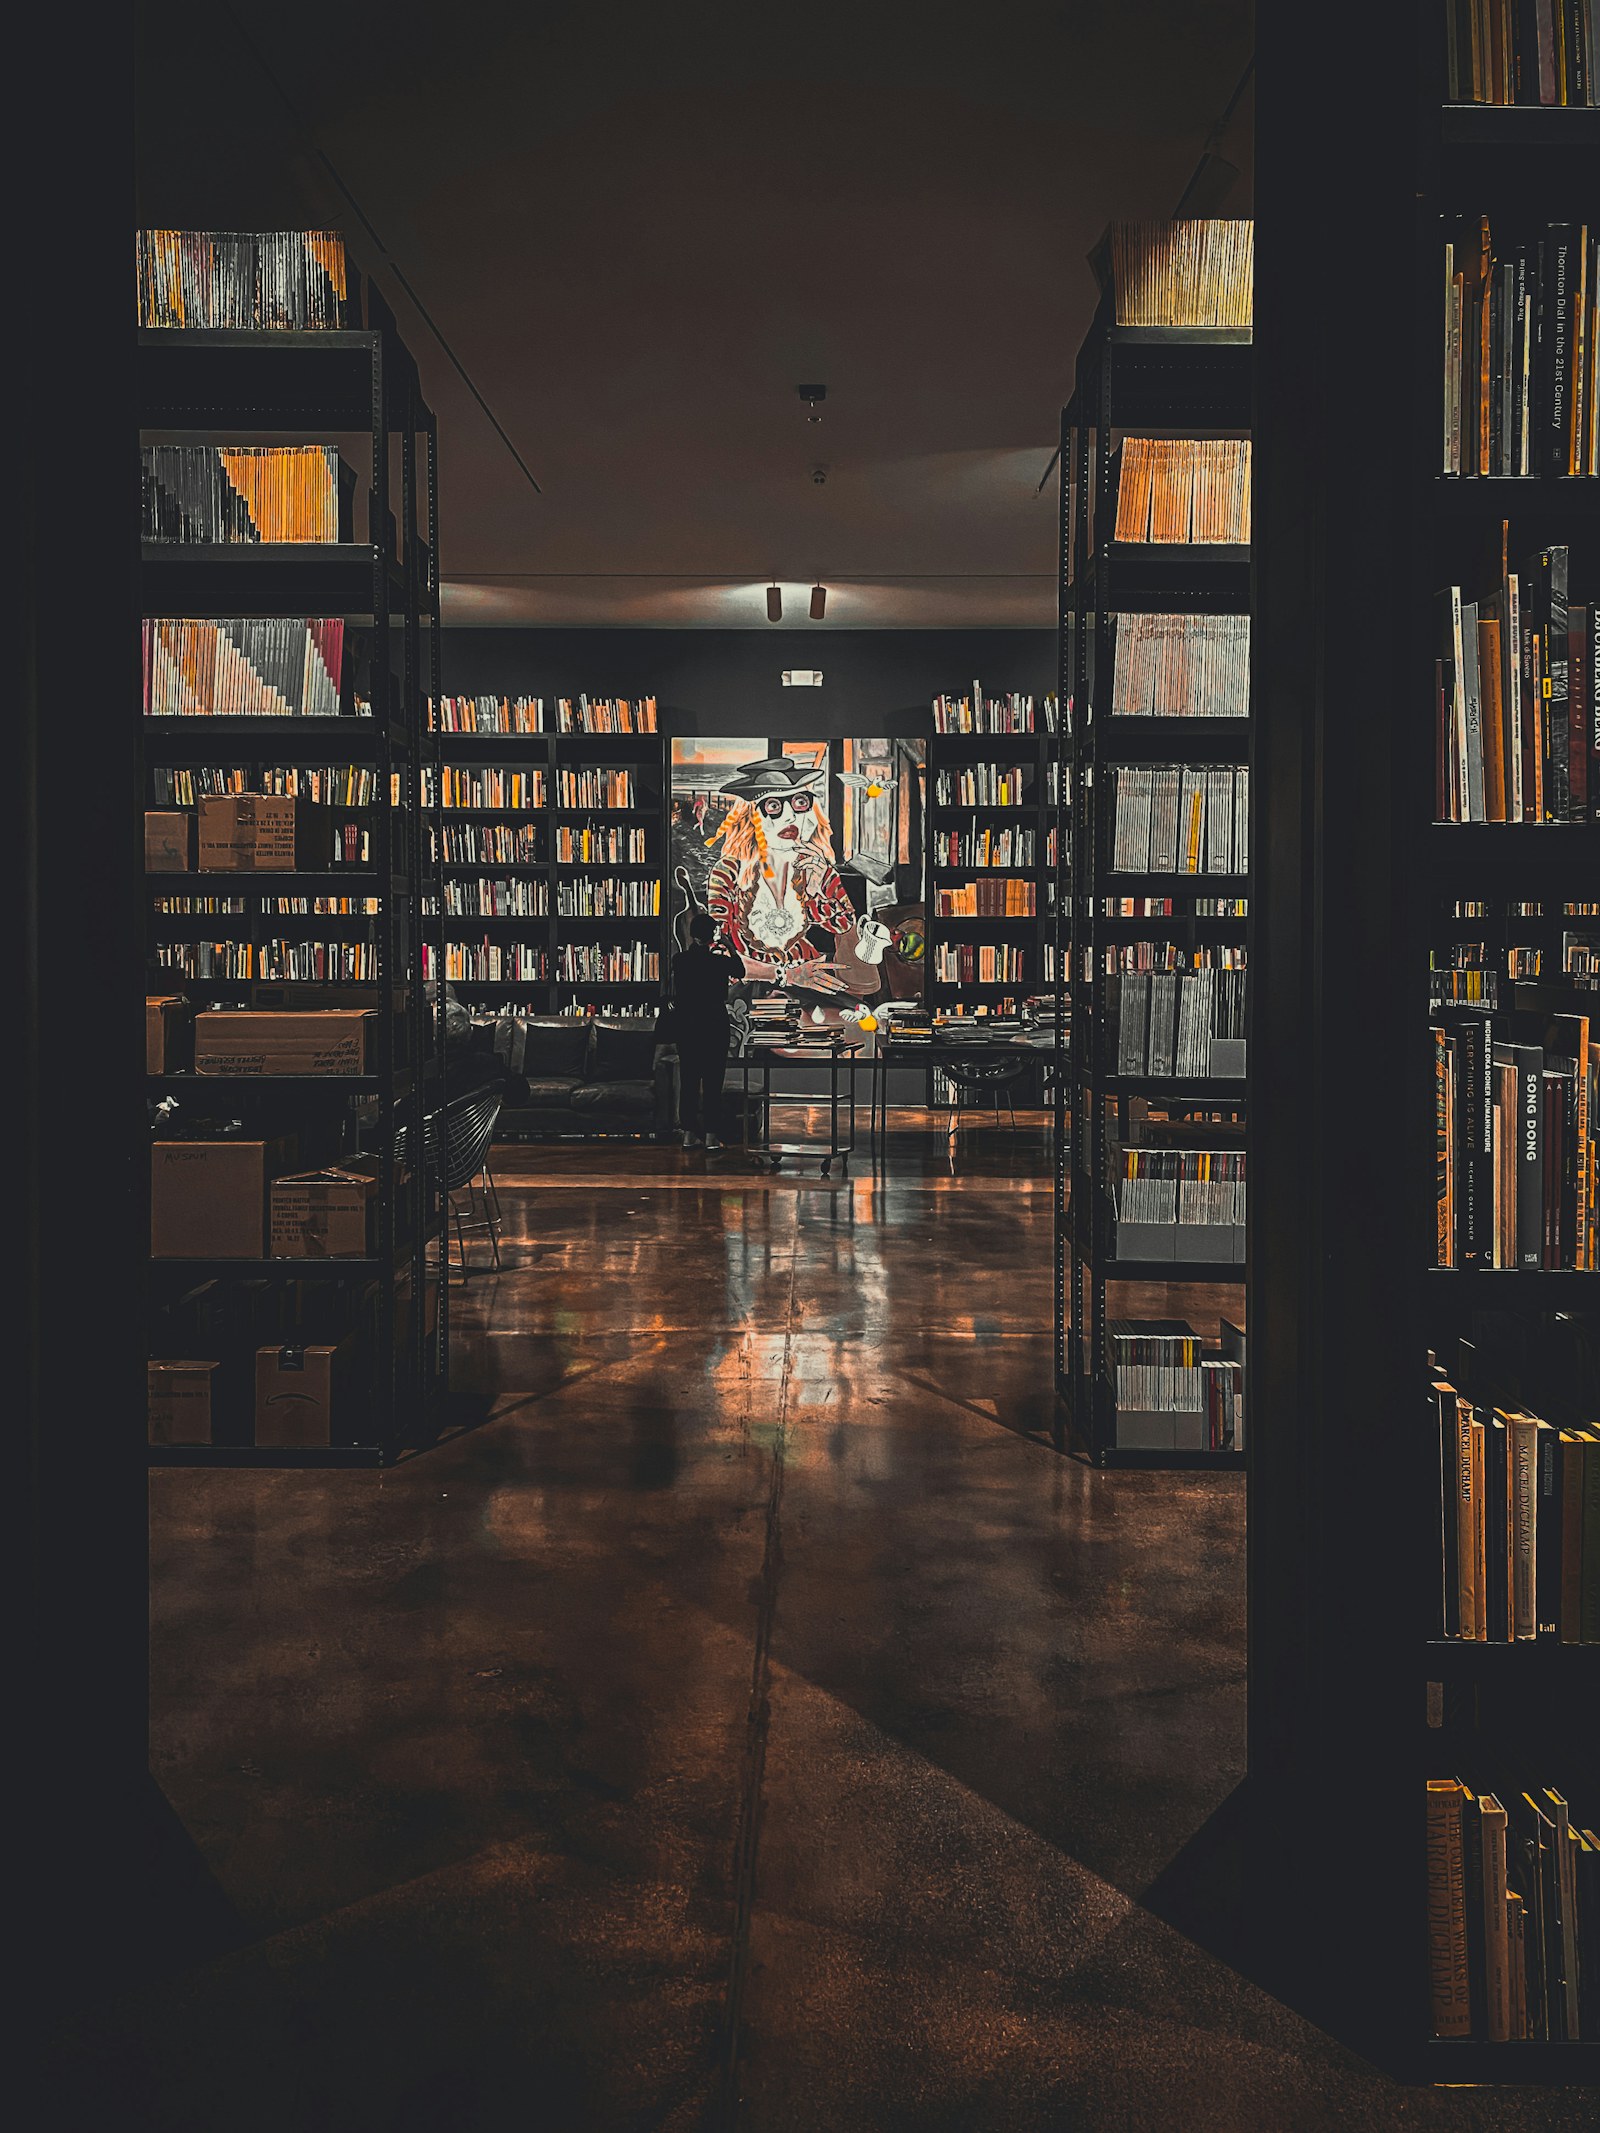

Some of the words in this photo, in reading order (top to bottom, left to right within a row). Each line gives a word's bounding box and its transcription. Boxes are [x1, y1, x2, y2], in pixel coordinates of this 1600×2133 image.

[1556, 246, 1568, 295] Thornton
[1518, 282, 1526, 306] Omega
[1556, 298, 1566, 320] Dial
[1556, 322, 1565, 333] in
[1555, 336, 1565, 355] the
[1555, 357, 1565, 382] 21st
[1552, 384, 1564, 429] Century
[1512, 616, 1518, 624] DI
[1523, 627, 1532, 646] Mark
[1523, 646, 1531, 654] di
[1523, 654, 1532, 679] Suvero
[1484, 1019, 1492, 1053] MICHELE
[1466, 1029, 1475, 1099] EVERYTHING
[1484, 1053, 1492, 1070] OKA
[1484, 1071, 1492, 1097] DONER
[1526, 1073, 1537, 1115] SONG
[1466, 1103, 1475, 1114] IS
[1466, 1117, 1475, 1149] ALIVE
[1526, 1119, 1537, 1162] DONG
[1461, 1414, 1471, 1453] MARCEL
[1461, 1455, 1471, 1502] DUCHAMP
[1518, 1444, 1529, 1496] MARCEL
[1519, 1495, 1531, 1555] DUCHAMP
[1449, 1813, 1462, 1842] THE
[1427, 1812, 1449, 1899] MARCEL
[1450, 1846, 1465, 1925] COMPLETE
[1429, 1903, 1453, 2006] DUCHAMP
[1454, 1929, 1467, 1982] WORKS
[1455, 1985, 1468, 2005] OF
